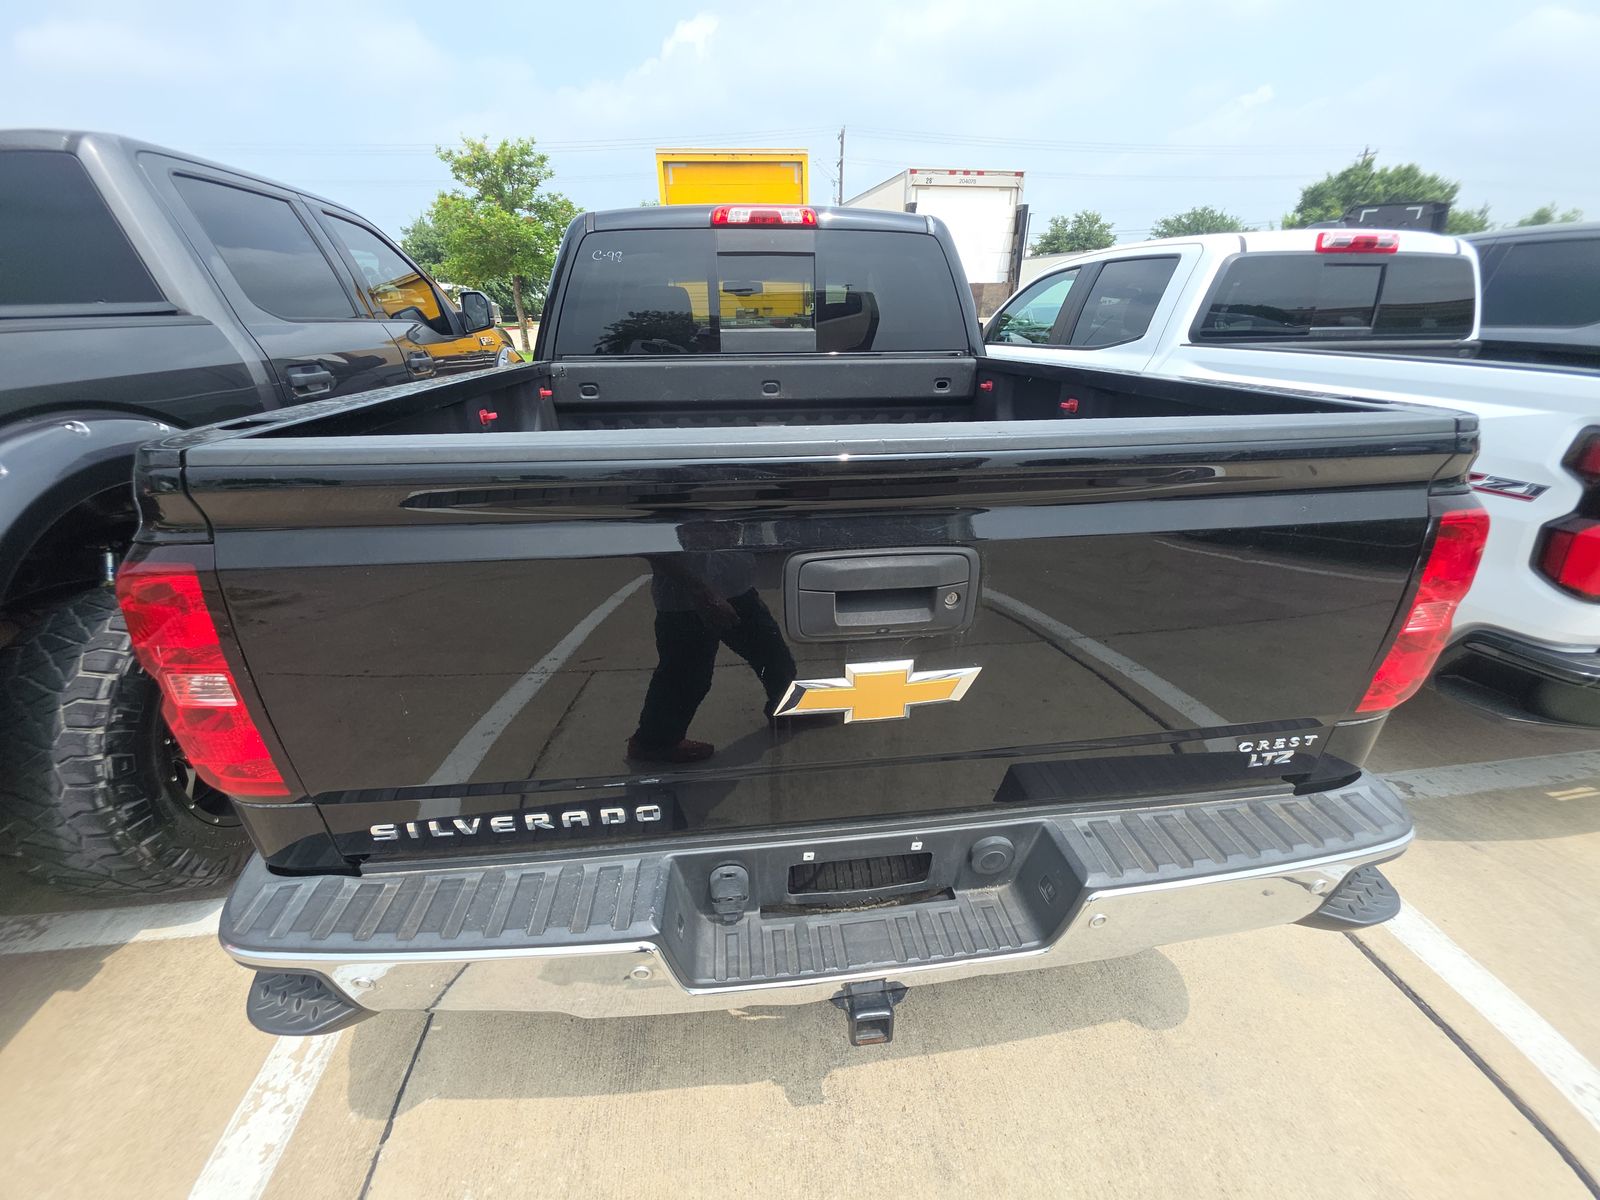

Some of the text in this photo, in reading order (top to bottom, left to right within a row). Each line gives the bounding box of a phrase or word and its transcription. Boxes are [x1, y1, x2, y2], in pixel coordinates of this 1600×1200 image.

[592, 249, 623, 263] C-98
[1238, 734, 1319, 753] CREST
[1248, 749, 1295, 768] LTZ
[369, 804, 661, 841] SILVERADO
